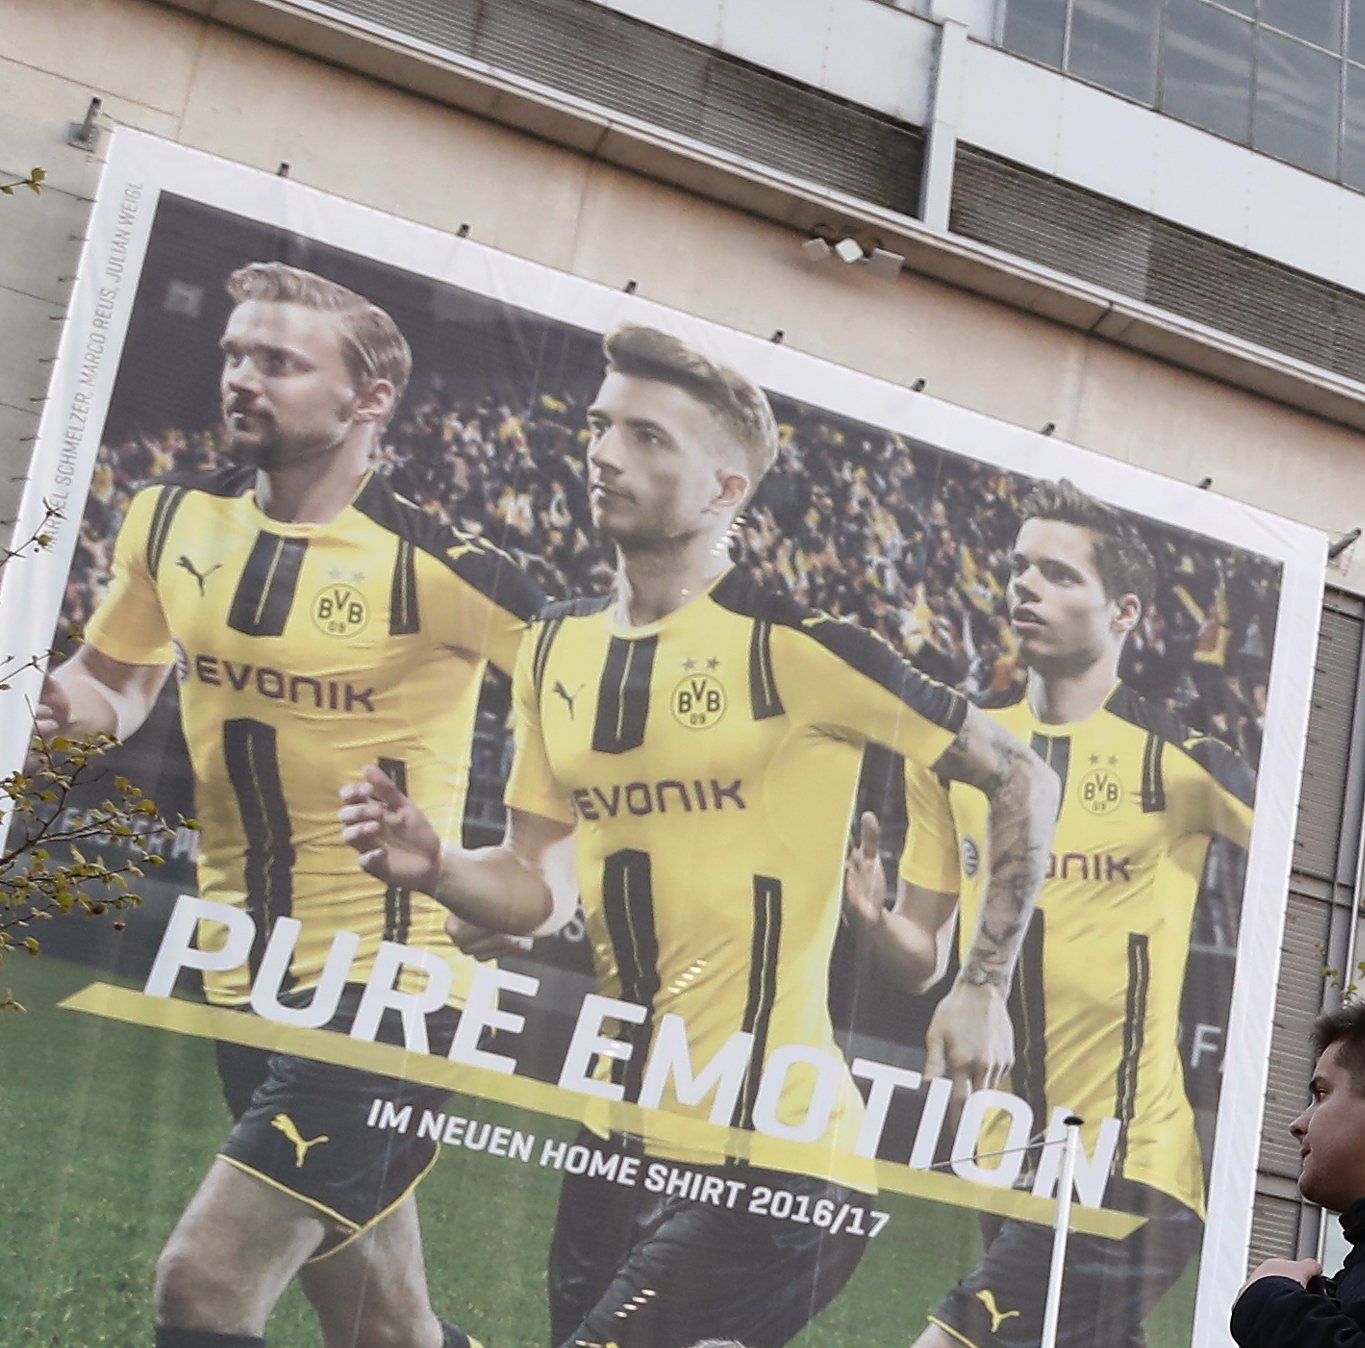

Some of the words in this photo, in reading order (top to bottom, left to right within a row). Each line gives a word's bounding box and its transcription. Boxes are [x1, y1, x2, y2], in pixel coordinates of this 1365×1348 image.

[195, 654, 375, 712] EVONIK
[573, 778, 747, 821] EVONIK
[143, 893, 540, 1076] PURE
[558, 990, 1124, 1210] EMOTION
[366, 1098, 413, 1134] IM
[416, 1110, 536, 1163] NEUEN
[539, 1141, 642, 1187] HOME
[644, 1164, 747, 1209] SHIRT
[748, 1184, 890, 1238] 2016/17
